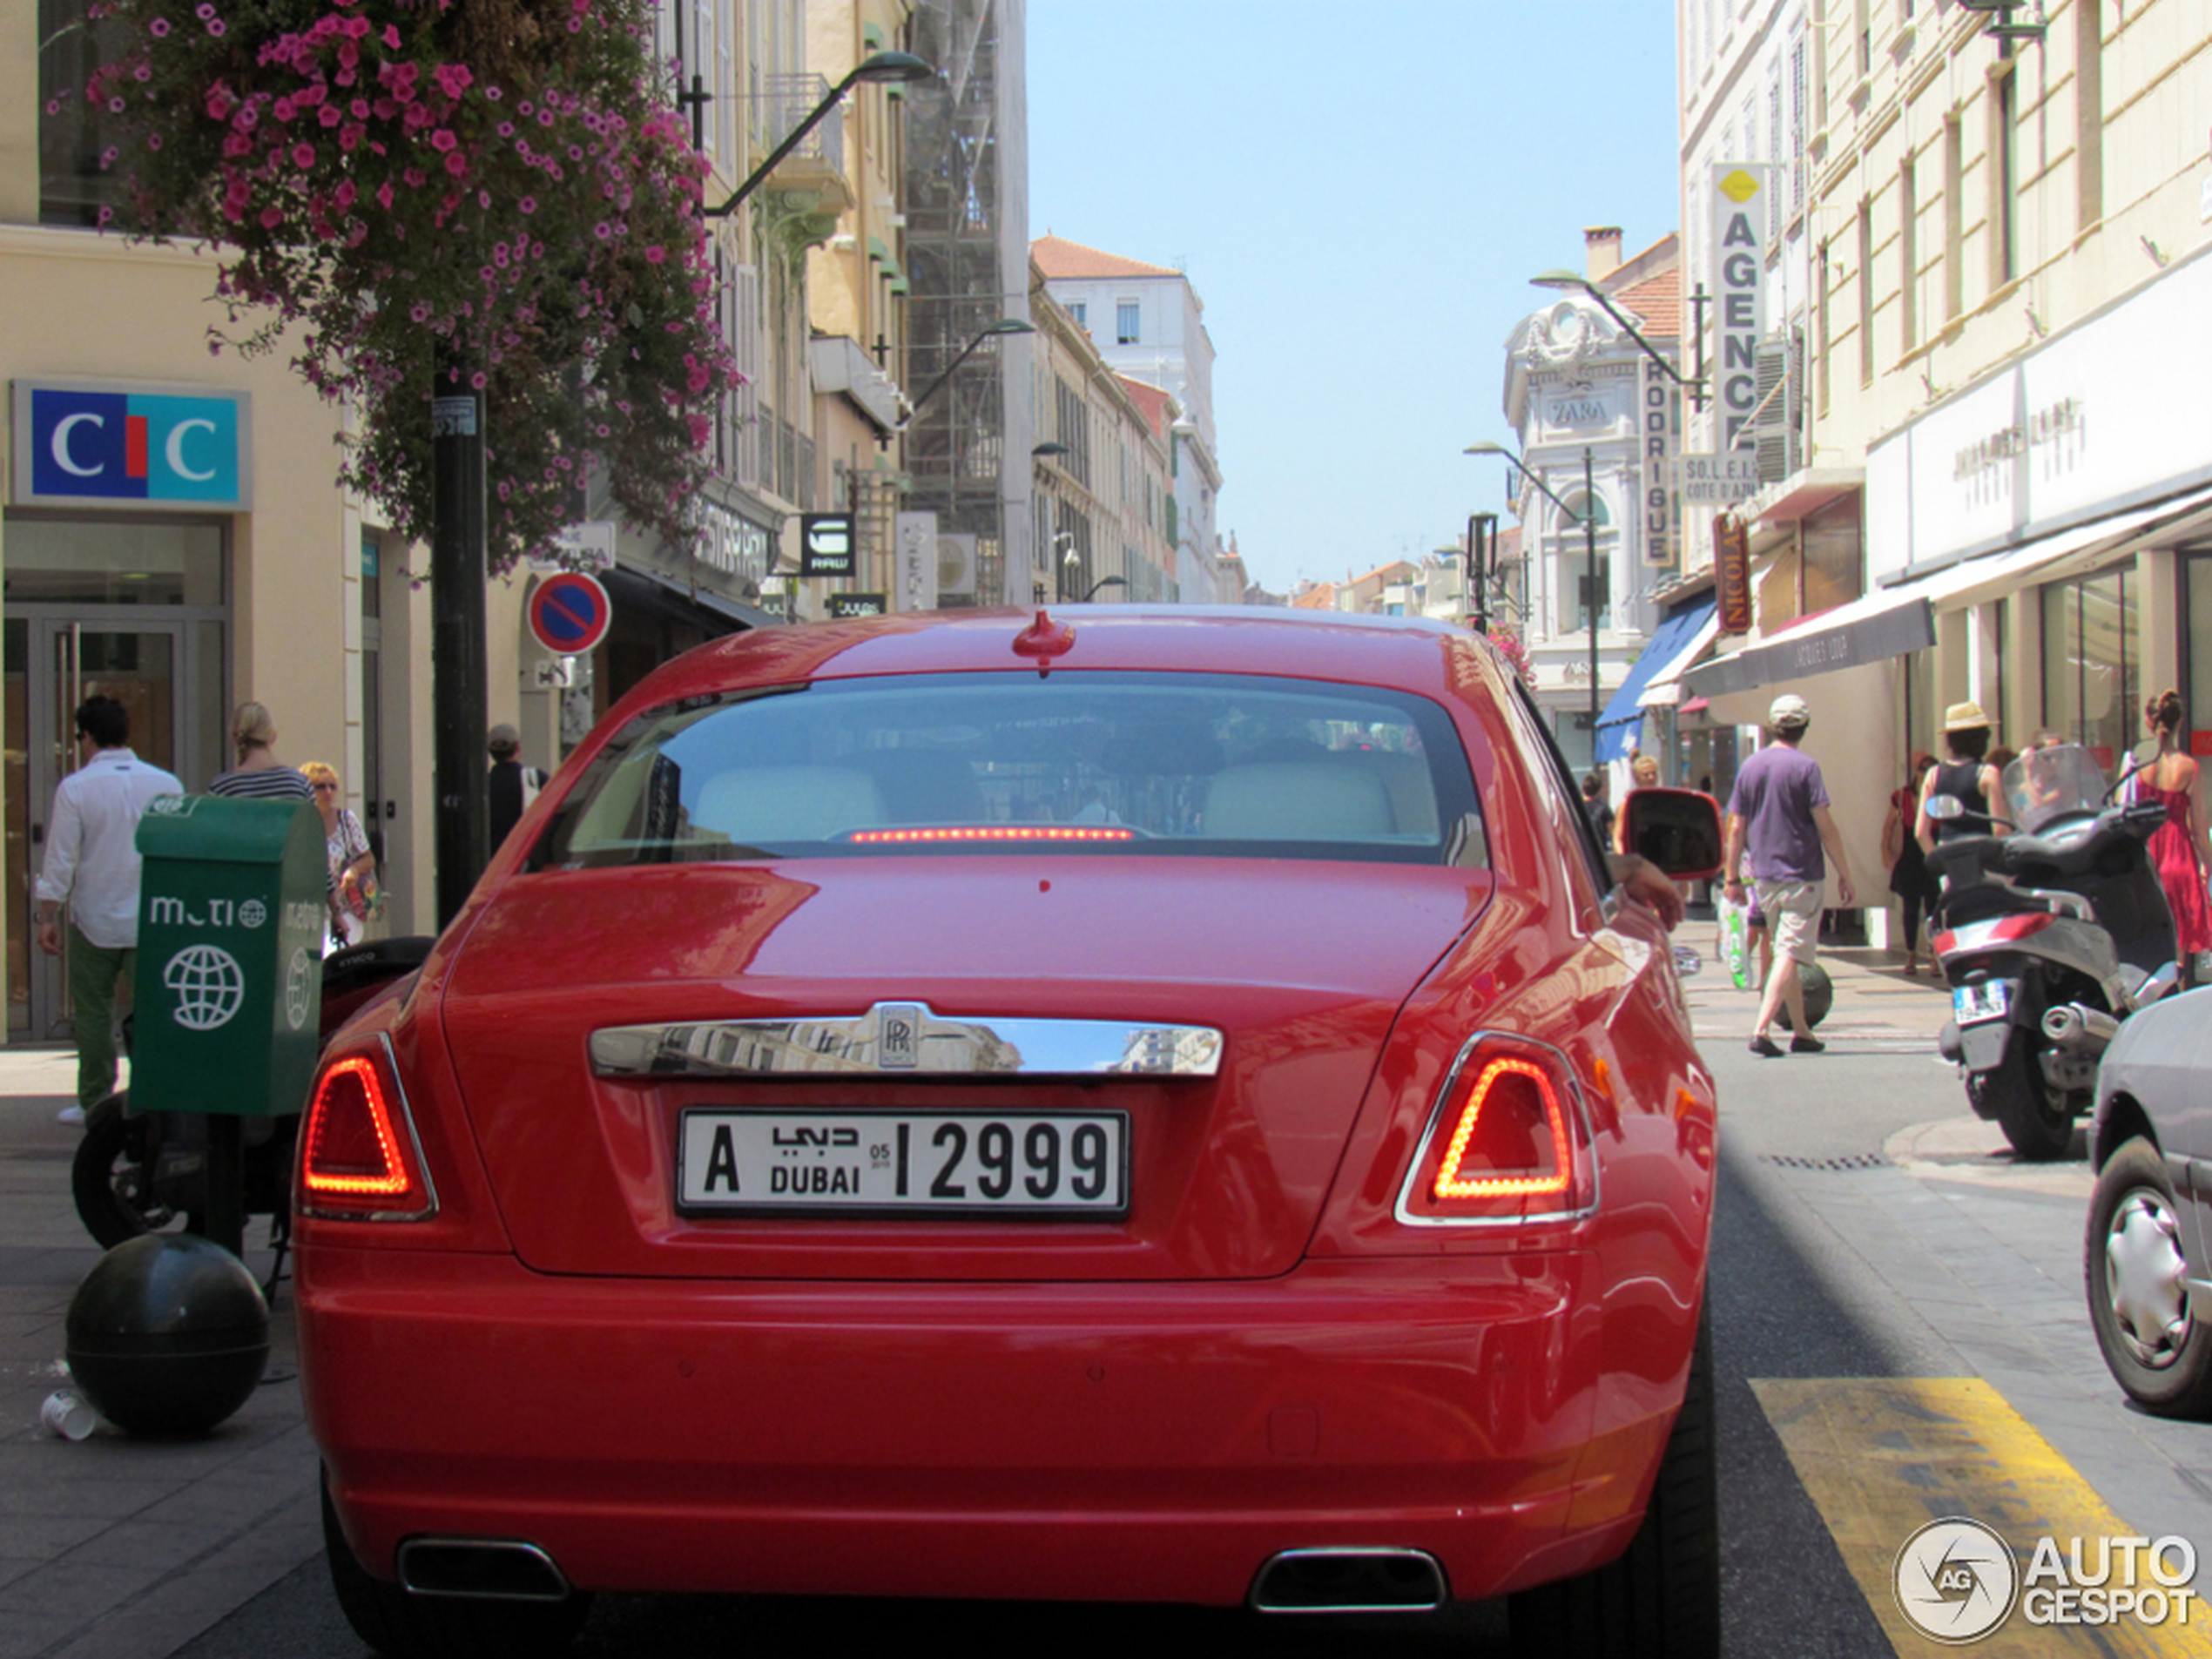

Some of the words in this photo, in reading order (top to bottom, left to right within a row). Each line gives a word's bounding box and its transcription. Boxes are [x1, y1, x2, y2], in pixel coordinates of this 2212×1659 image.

[1723, 212, 1757, 451] AGENCE
[1551, 401, 1608, 423] ZARA
[51, 413, 216, 482] CIC
[1647, 362, 1667, 559] RODRIGUE
[811, 557, 849, 570] RAW
[704, 1124, 739, 1193] A
[870, 1143, 890, 1159] 05
[771, 1165, 860, 1195] DUBAI
